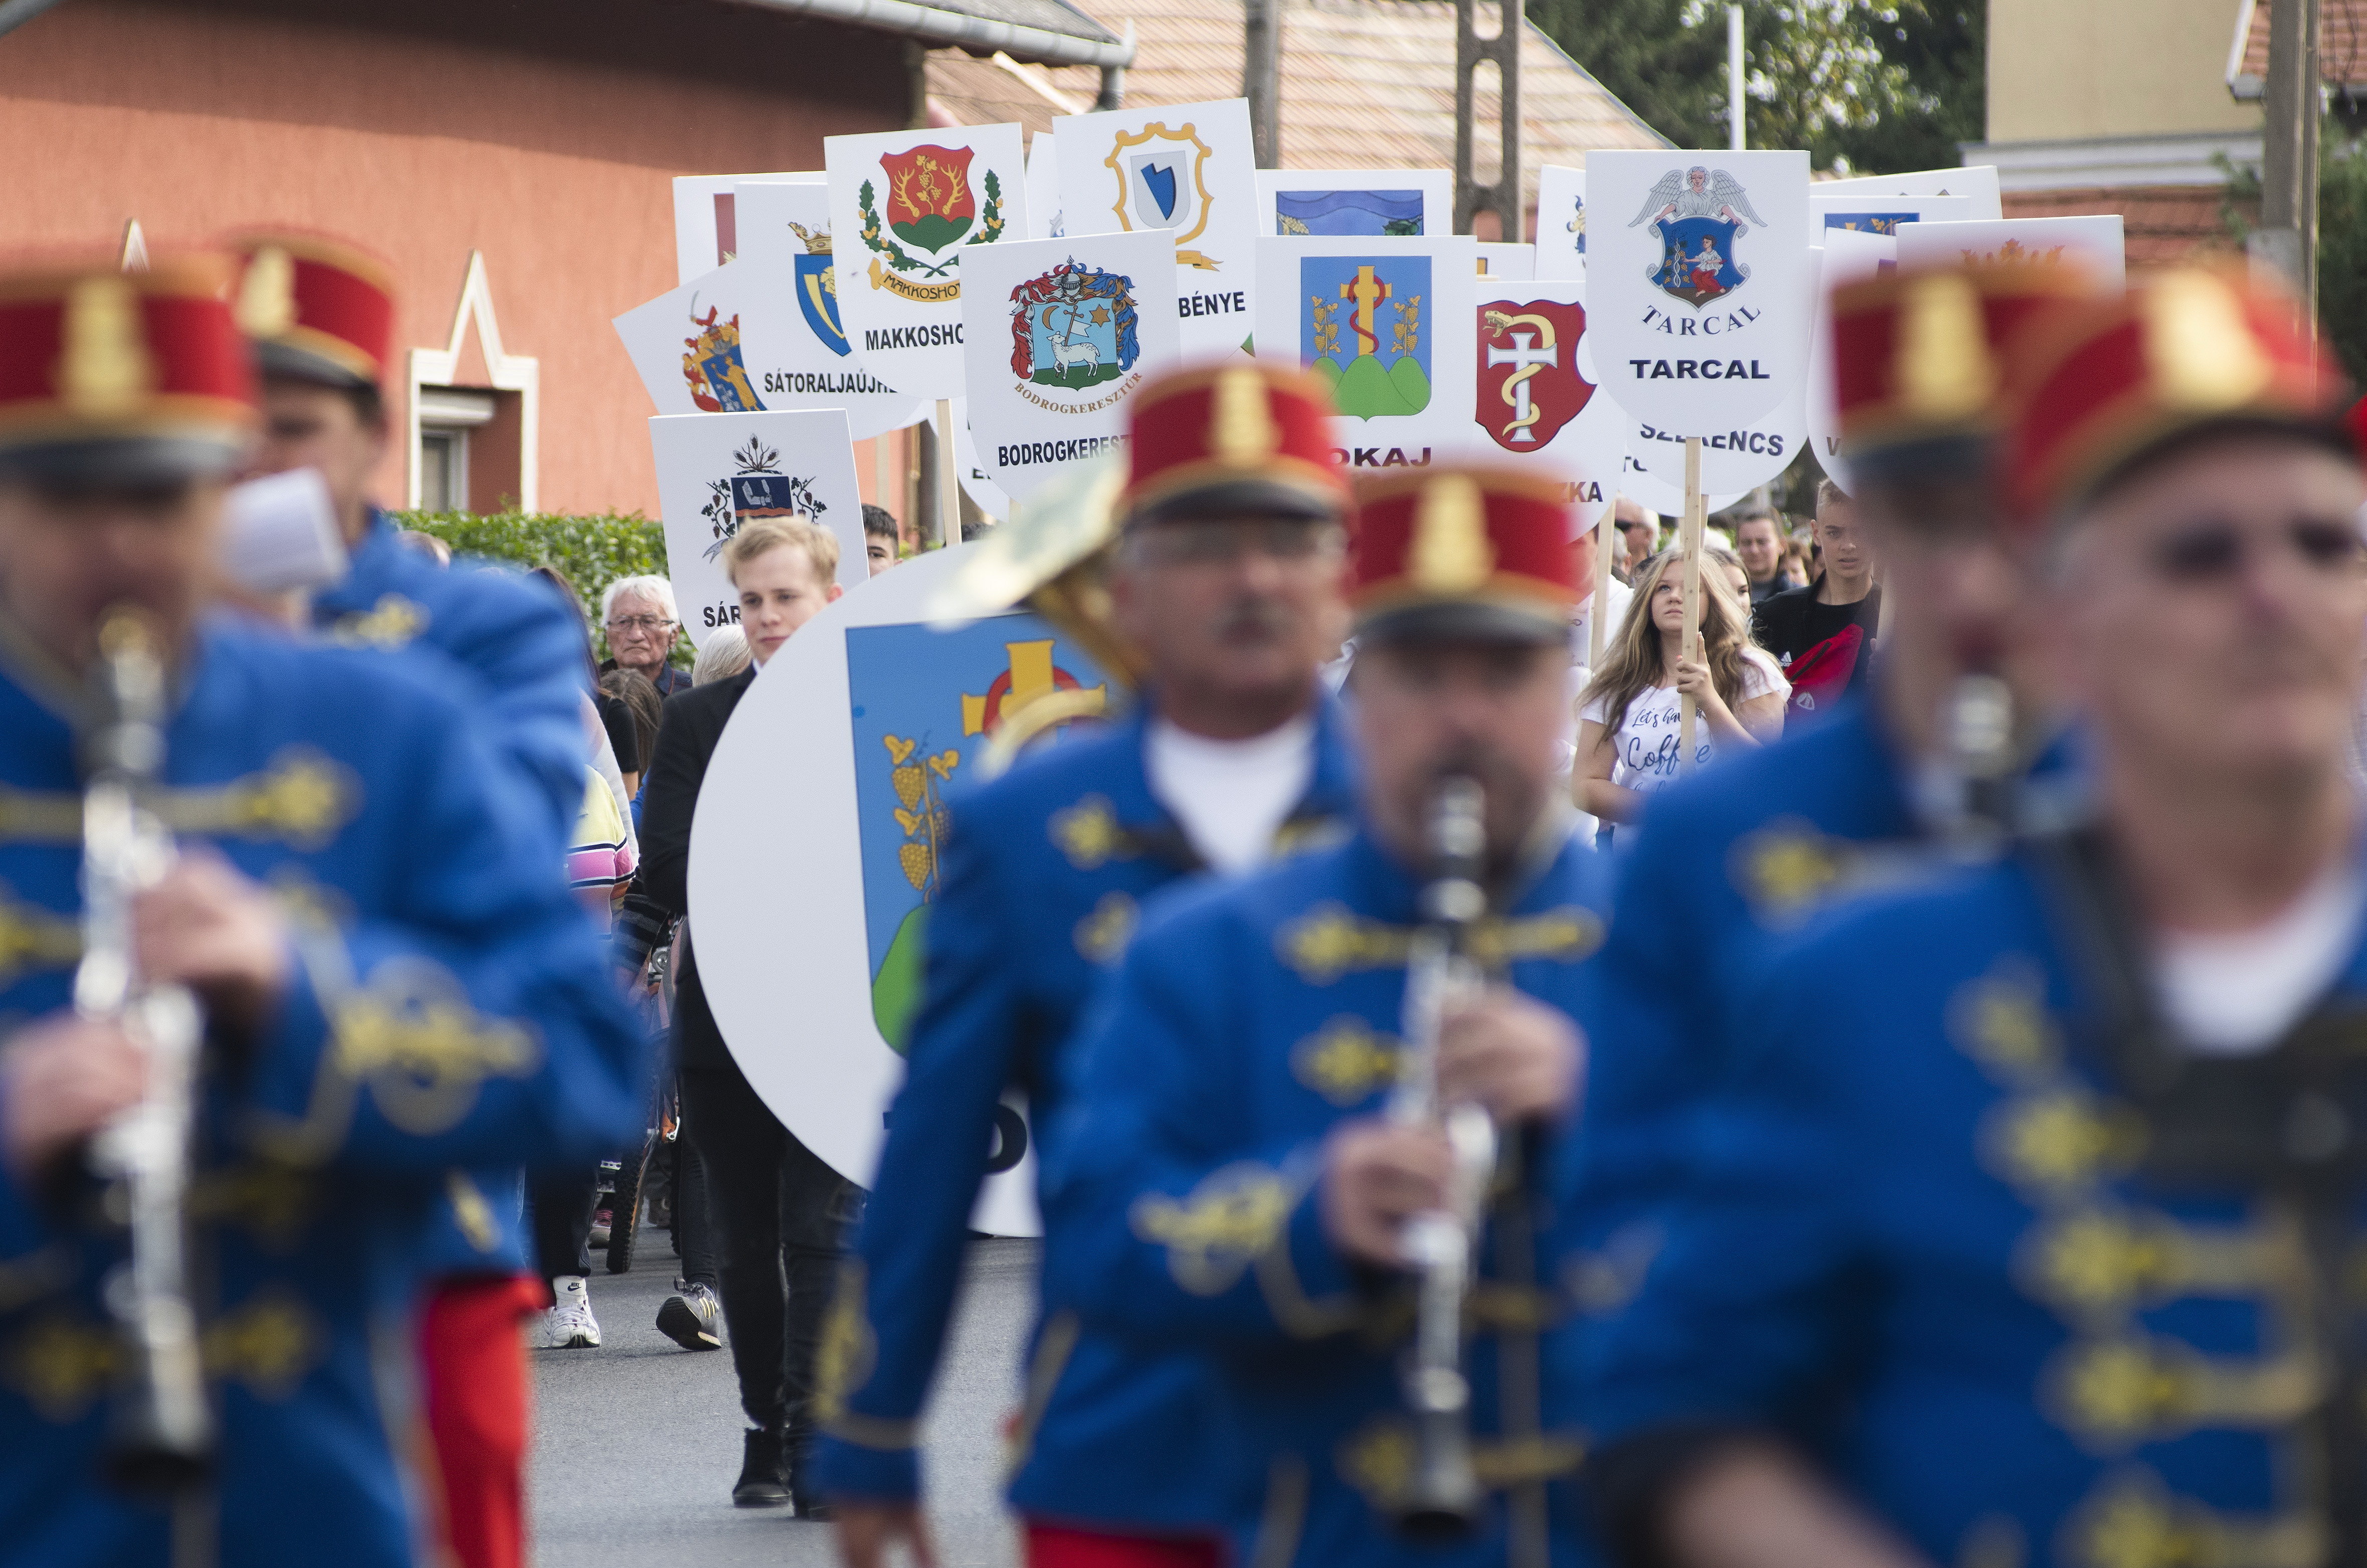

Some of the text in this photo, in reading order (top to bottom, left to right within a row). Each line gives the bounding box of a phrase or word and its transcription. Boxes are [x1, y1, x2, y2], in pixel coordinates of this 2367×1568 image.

[1178, 291, 1246, 318] BÉNYE
[1641, 305, 1761, 336] TARCAL
[1629, 359, 1771, 380] TARCAL
[1014, 372, 1143, 414] BODROGKERESZTÚR
[1632, 708, 1659, 728] Let's
[1628, 734, 1713, 775] Coffe
